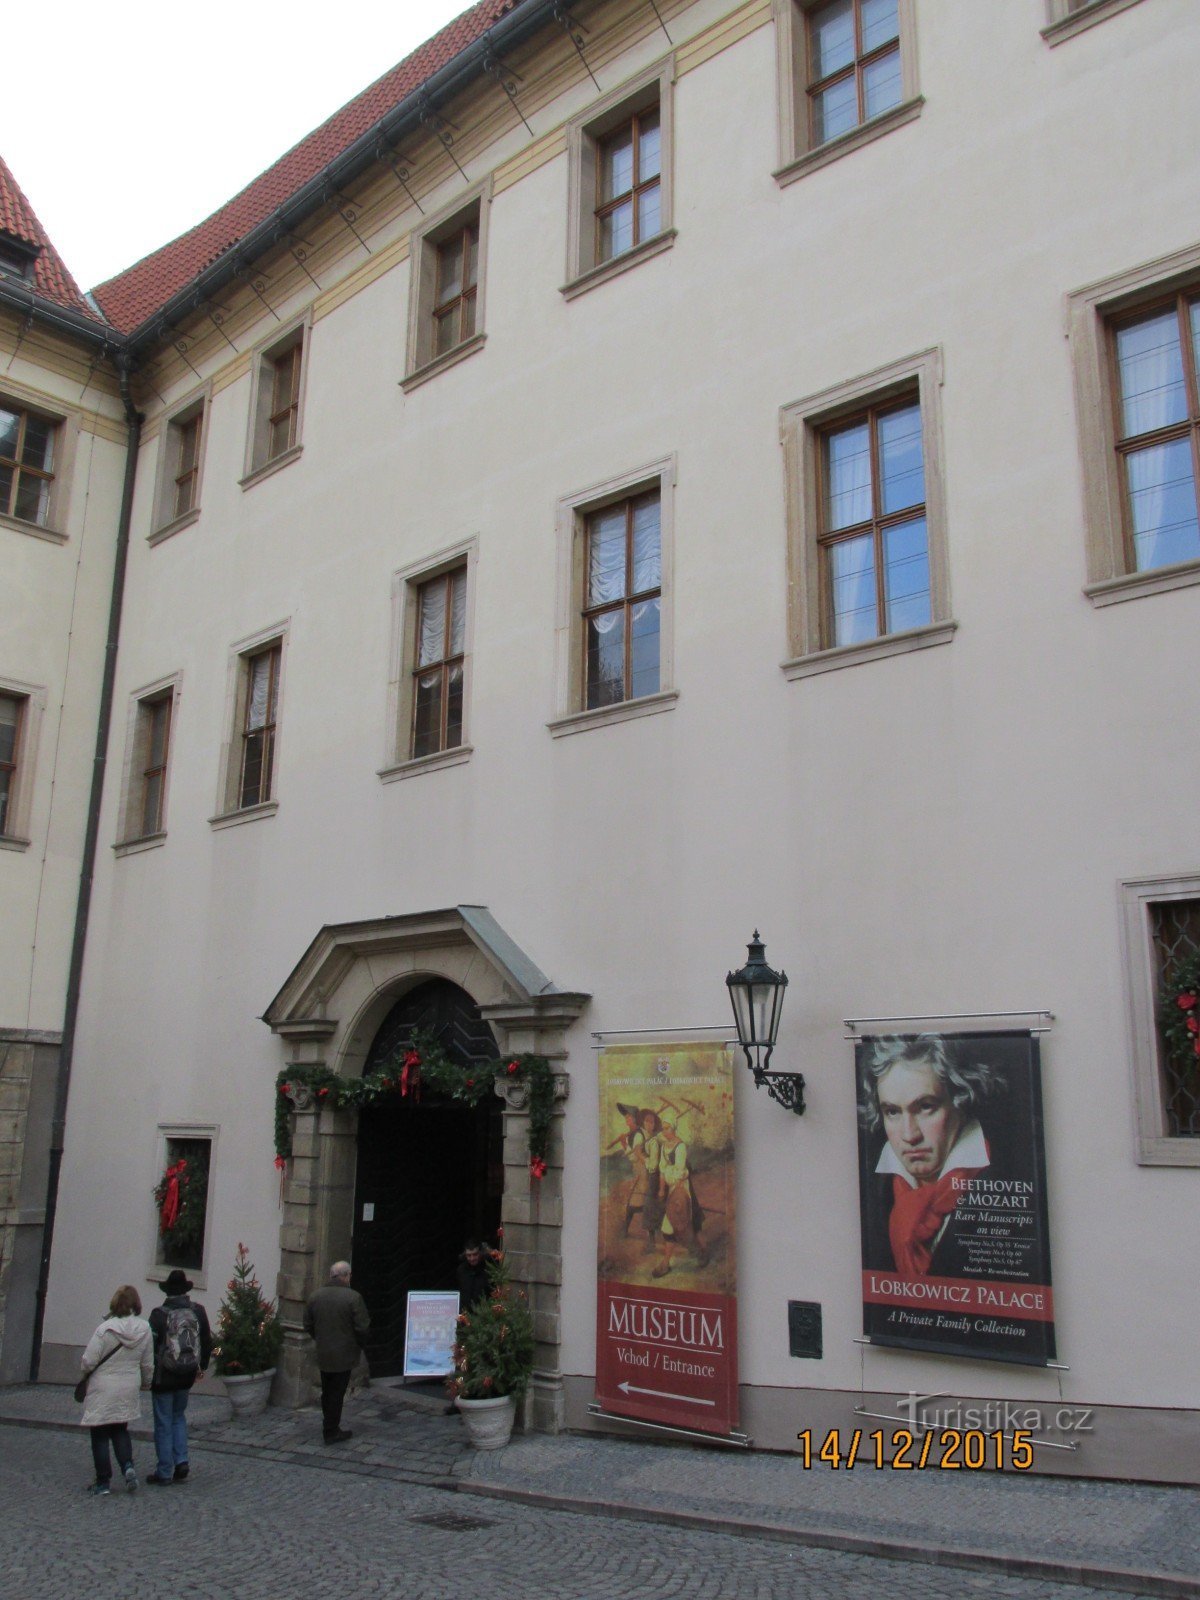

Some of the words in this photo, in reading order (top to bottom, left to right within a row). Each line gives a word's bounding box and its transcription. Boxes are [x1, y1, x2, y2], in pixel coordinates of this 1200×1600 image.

[951, 1177, 1033, 1193] BEETHOVEN
[956, 1195, 966, 1205] &
[968, 1192, 1029, 1207] MOZART
[954, 1210, 976, 1221] Rare
[978, 1211, 1033, 1227] Manuscripts
[990, 1226, 1011, 1235] view
[871, 1276, 971, 1303] LOBKOWICZ
[977, 1286, 1044, 1310] PALACE
[608, 1301, 724, 1348] MUSEUM
[887, 1311, 896, 1322] A
[898, 1311, 934, 1326] Private
[936, 1316, 971, 1334] Family
[974, 1319, 1026, 1337] Collection
[617, 1347, 649, 1367] Vchod
[653, 1352, 660, 1369] /
[663, 1355, 715, 1378] Entrance
